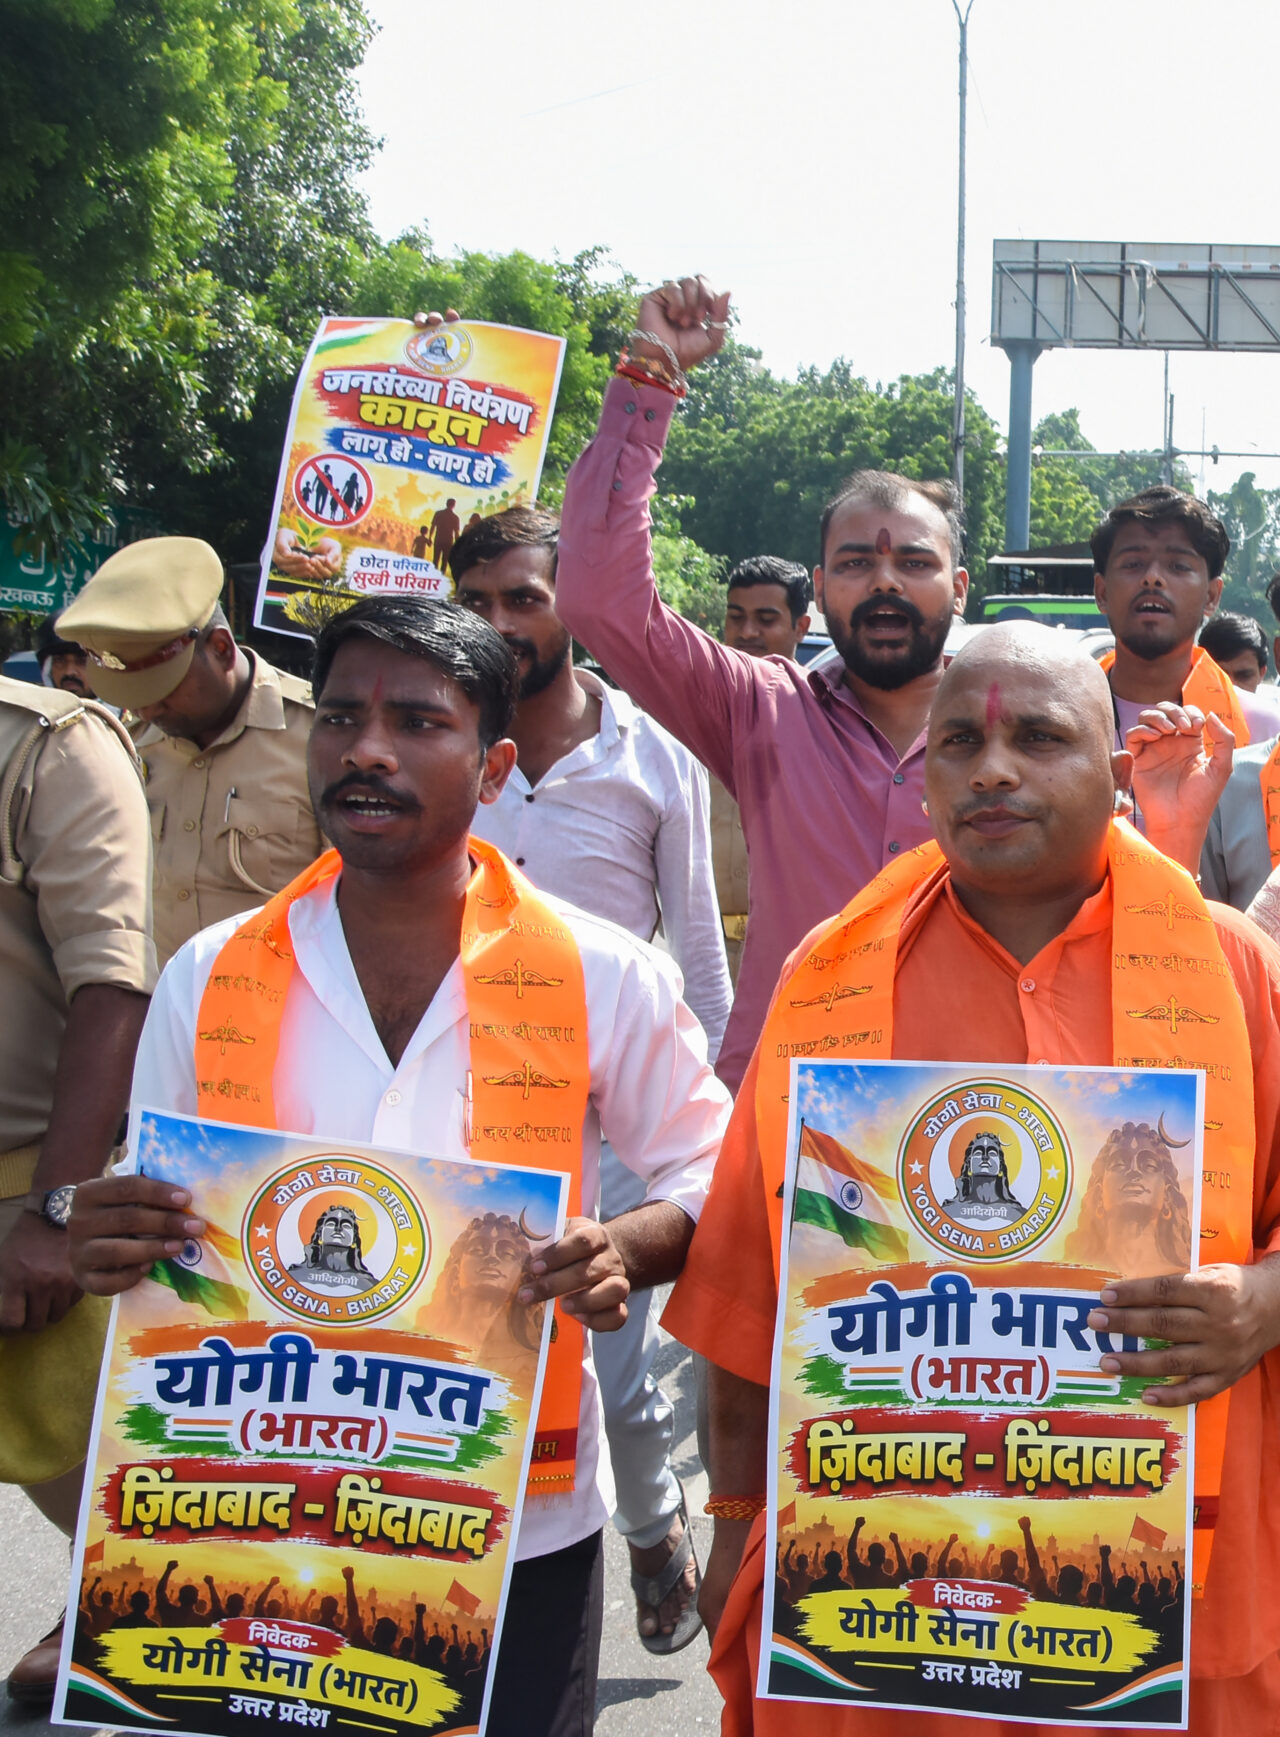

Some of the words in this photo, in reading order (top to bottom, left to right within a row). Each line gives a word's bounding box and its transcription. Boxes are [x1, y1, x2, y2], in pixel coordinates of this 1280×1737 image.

[322, 368, 443, 405] जनसंख्या
[446, 378, 533, 434] नियंत्रण
[360, 395, 489, 446] कानून
[342, 431, 388, 463] लागू
[390, 436, 413, 463] हो
[427, 449, 472, 484] लागू
[472, 454, 497, 483] हो
[353, 570, 390, 589] सुखी
[395, 575, 442, 591] परिवार
[359, 554, 390, 570] छोटा
[392, 559, 430, 573] परिवार
[1128, 953, 1158, 970] जय
[1161, 952, 1183, 973] श्री
[1184, 957, 1213, 974] राम
[482, 1023, 509, 1039] जय
[512, 1021, 532, 1040] श्री
[533, 1025, 561, 1041] राम
[483, 1126, 511, 1141] जय
[514, 1122, 532, 1142] श्री
[534, 1126, 559, 1142] राम
[924, 1100, 962, 1139] योगी
[962, 1090, 1002, 1110] सेना
[1018, 1107, 1054, 1152] भारत
[273, 1171, 314, 1206] योगी
[317, 1164, 361, 1184] सेना
[377, 1186, 412, 1230] भारत
[912, 1184, 941, 1227] YOGI
[938, 1223, 984, 1251] SENA
[999, 1193, 1055, 1250] BHARAT
[960, 1205, 1008, 1217] आदियोगी
[256, 1246, 286, 1289] YOGI
[282, 1286, 331, 1315] SENA
[347, 1267, 410, 1315] BHARAT
[307, 1272, 359, 1286] आदियोगी
[827, 1273, 978, 1355] योगी
[155, 1334, 319, 1408] योगी
[332, 1354, 491, 1427] भारत
[911, 1354, 1050, 1401] (भारत)
[240, 1408, 389, 1458] (भारत)
[807, 1419, 966, 1492] ज़िंदाबाद
[1004, 1418, 1165, 1492] ज़िंदाबाद
[120, 1467, 296, 1535] ज़िंदाबाद
[334, 1474, 493, 1555] ज़िंदाबाद
[838, 1598, 919, 1643] योगी
[928, 1605, 999, 1651] सेना
[1007, 1619, 1113, 1664] (भारत)
[142, 1636, 231, 1676] योगी
[240, 1644, 313, 1689] सेना
[319, 1663, 418, 1714] (भारत)
[921, 1660, 966, 1684] उत्तर
[970, 1661, 1022, 1689] प्रदेश
[228, 1694, 276, 1718] उत्तर
[279, 1699, 331, 1728] प्रदेश
